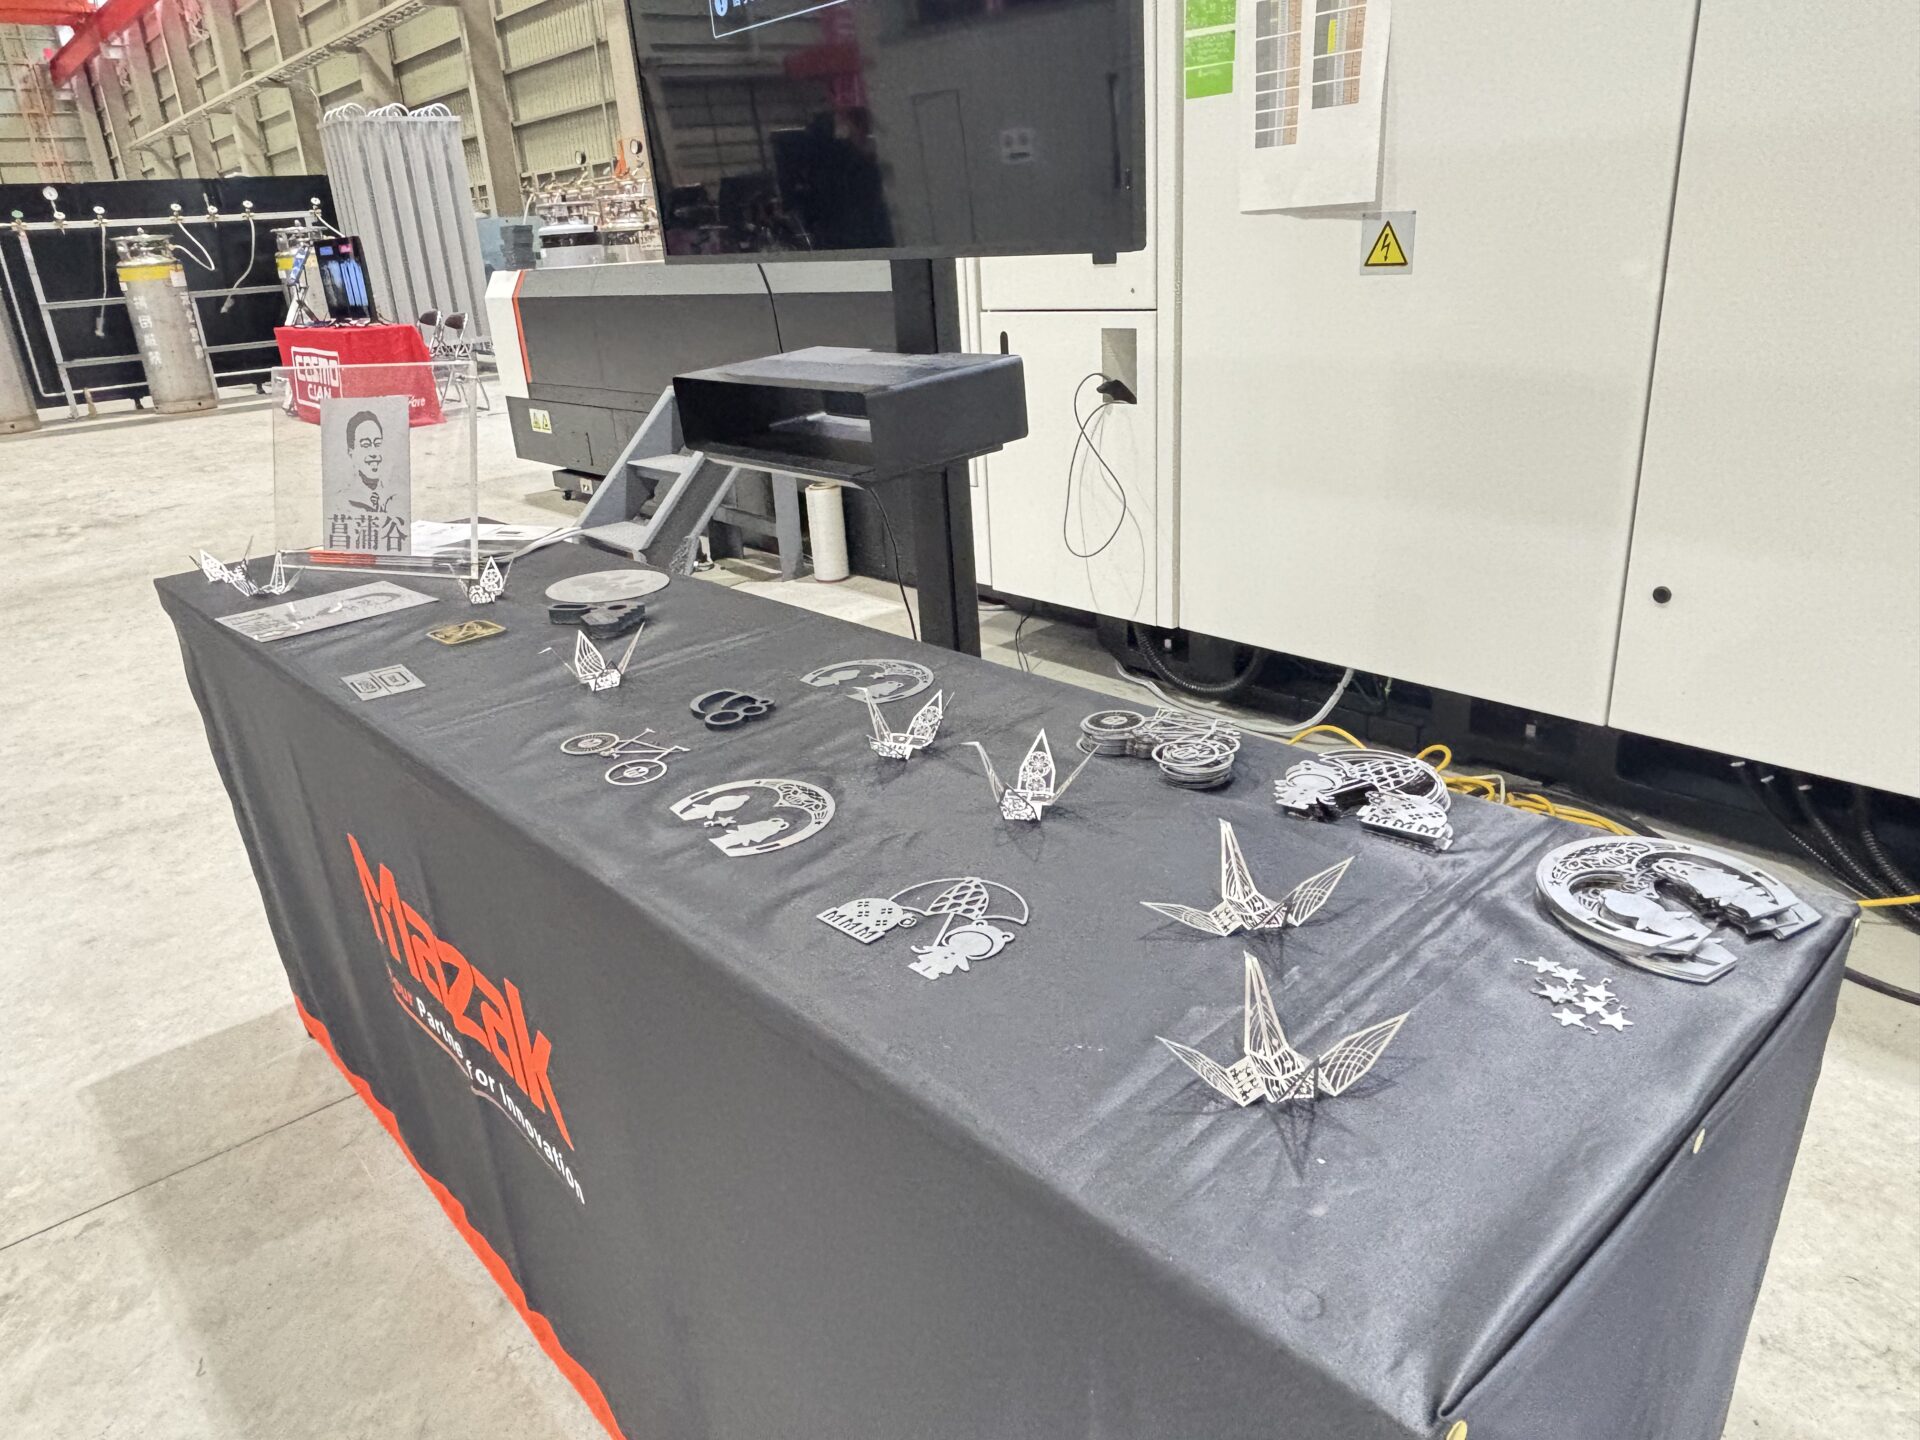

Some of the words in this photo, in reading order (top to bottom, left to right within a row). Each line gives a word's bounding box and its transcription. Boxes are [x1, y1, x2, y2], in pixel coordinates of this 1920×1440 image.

[295, 355, 340, 388] COSMO
[328, 513, 408, 552] 菖蒲谷
[347, 832, 575, 1152] Mazak
[415, 996, 464, 1059] Partne
[499, 1082, 586, 1205] Innovation
